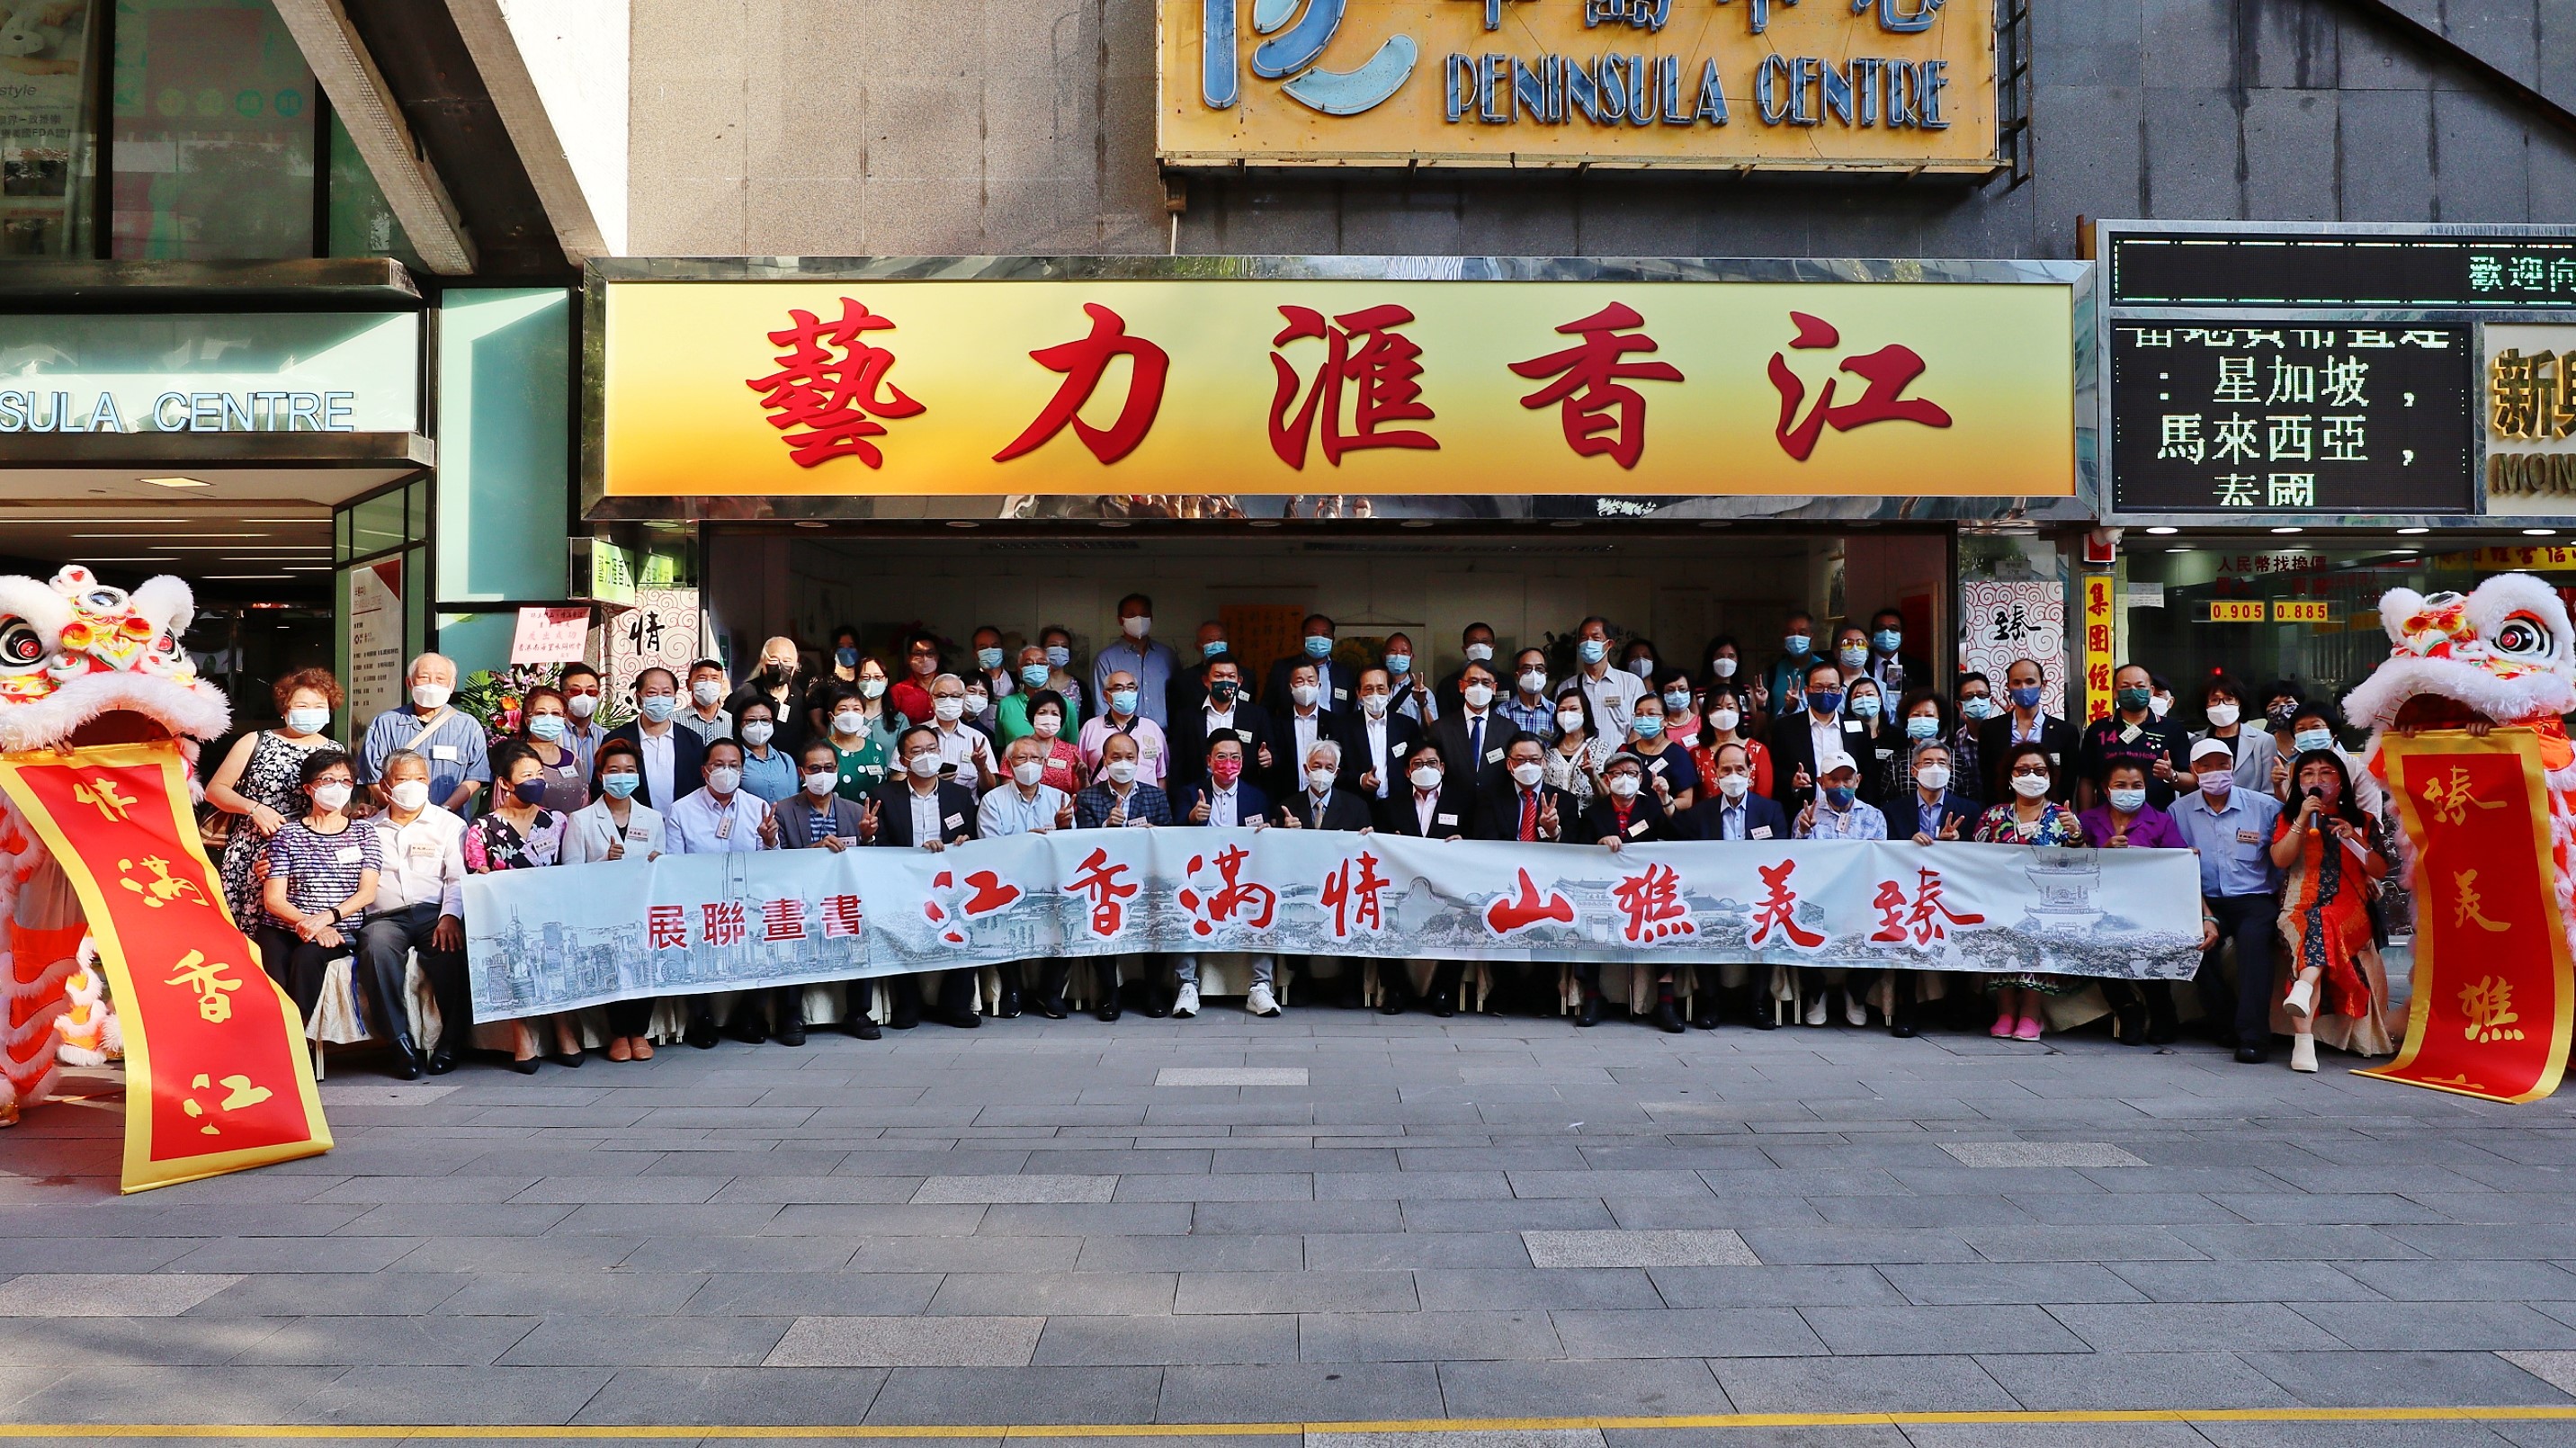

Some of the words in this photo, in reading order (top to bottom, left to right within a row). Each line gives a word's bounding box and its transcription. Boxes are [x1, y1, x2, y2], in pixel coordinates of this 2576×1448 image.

[1445, 52, 1730, 126] PENINSULA
[1756, 53, 1950, 130] CENTRE
[0, 390, 123, 433] SULA
[153, 390, 354, 433] CENTRE
[2213, 604, 2262, 619] 0.905
[2276, 604, 2326, 619] 0.885
[629, 611, 665, 656] 情
[2098, 729, 2118, 746] 14
